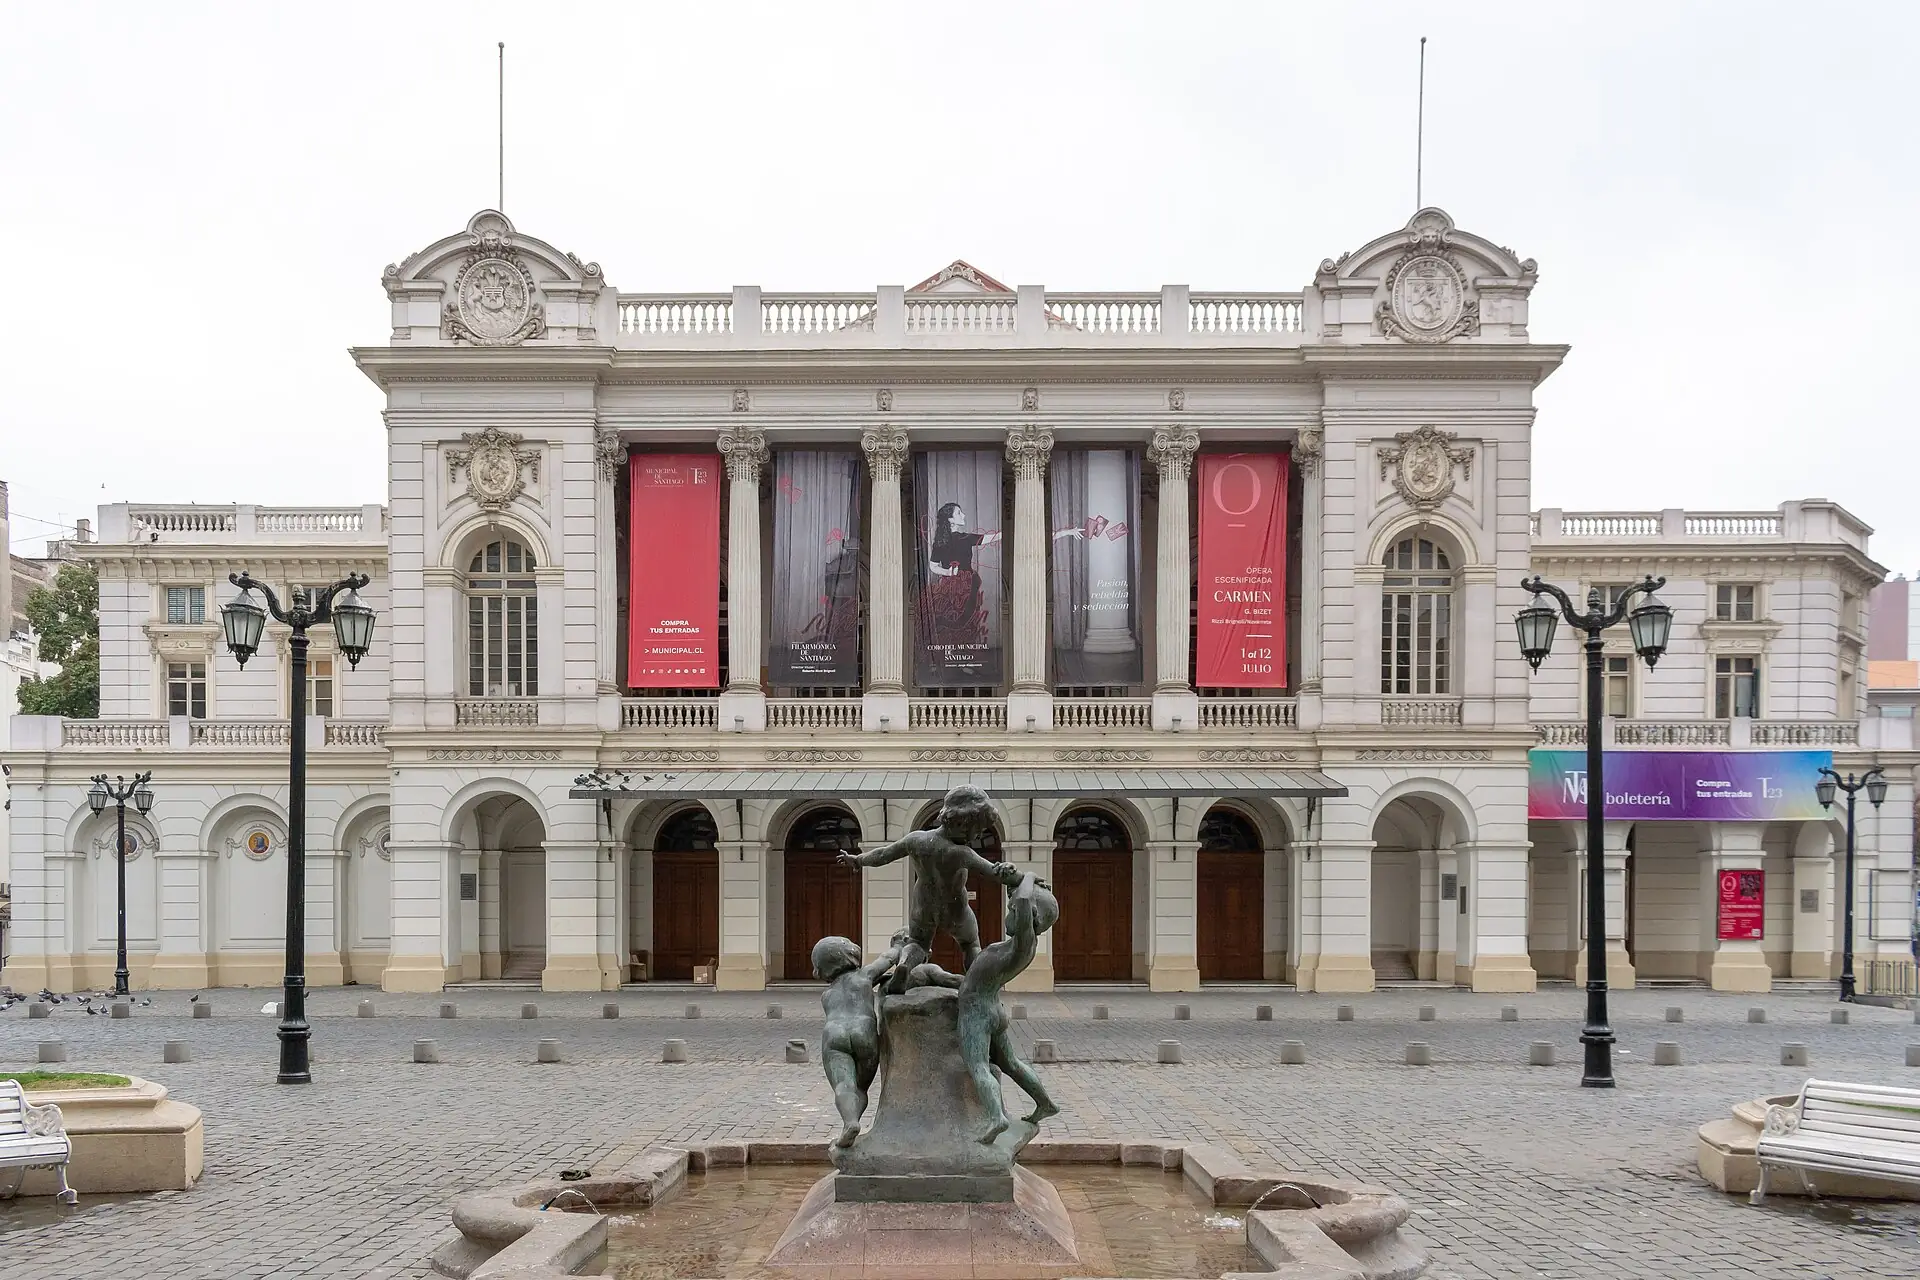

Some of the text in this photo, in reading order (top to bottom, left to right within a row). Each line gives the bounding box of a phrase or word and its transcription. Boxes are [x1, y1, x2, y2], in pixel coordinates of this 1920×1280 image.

[1214, 576, 1273, 584] ESCENIFICADA
[1214, 590, 1271, 602] CARMEN
[1073, 601, 1130, 613] y seducción
[1241, 647, 1272, 659] 1 al 12
[1241, 664, 1272, 673] JULIO
[1696, 779, 1732, 789] Compra
[1605, 791, 1671, 805] boletería
[1696, 790, 1753, 798] tus entradas
